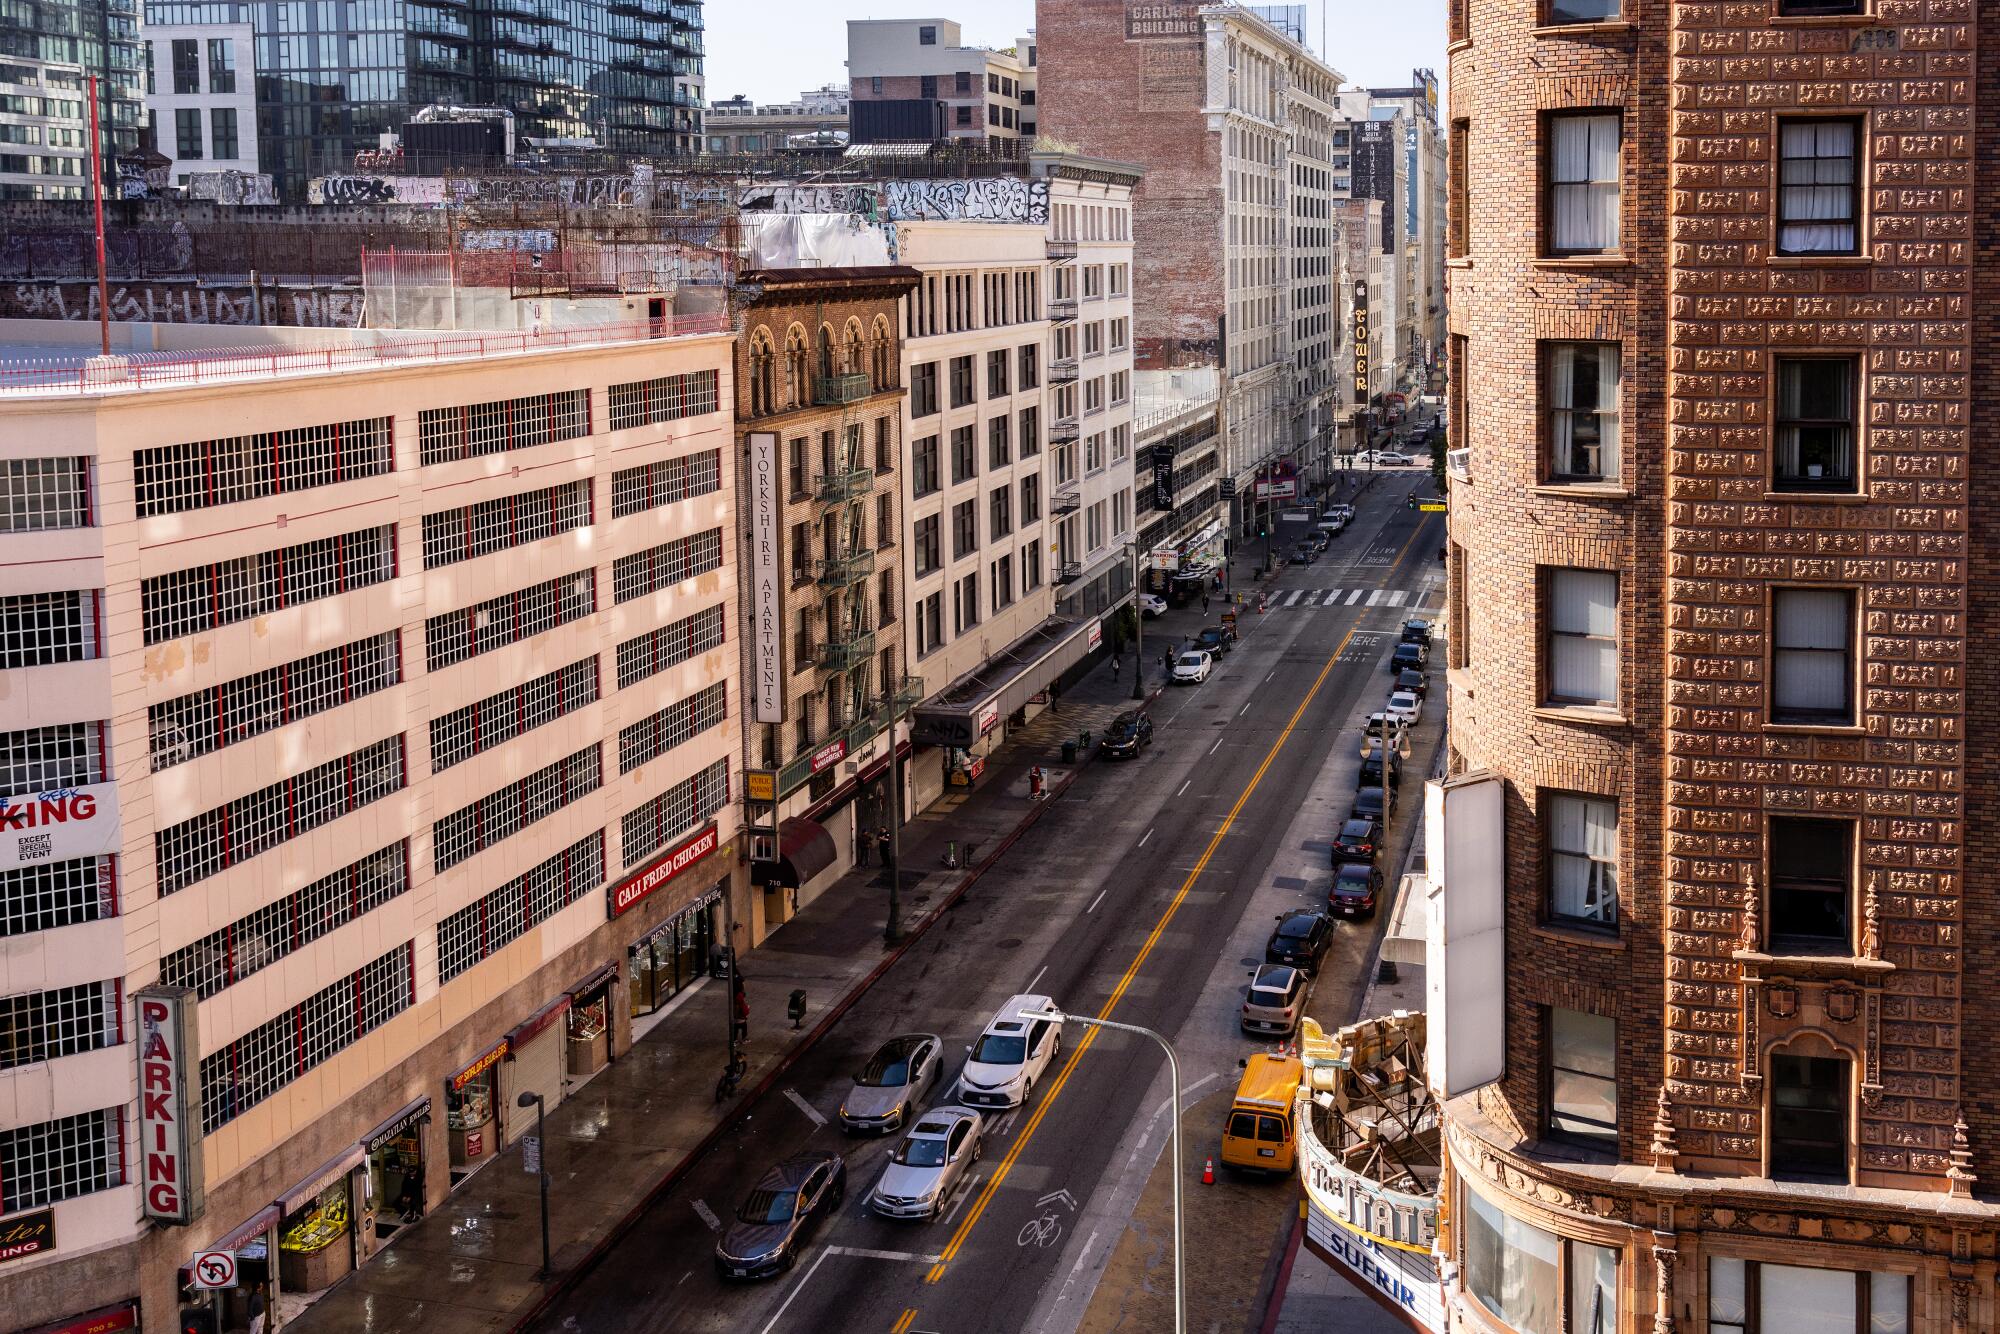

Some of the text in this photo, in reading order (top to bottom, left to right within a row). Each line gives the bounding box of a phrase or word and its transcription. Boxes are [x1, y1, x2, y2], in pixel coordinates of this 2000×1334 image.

[1132, 21, 1198, 34] BUILDING
[1364, 122, 1380, 131] 818
[1355, 309, 1368, 391] TOWER
[757, 446, 771, 567] YORKSHIRE
[1348, 635, 1380, 646] HERE
[38, 788, 79, 801] SEEK
[18, 833, 51, 845] EXCEPT
[20, 841, 50, 852] SPECIAL
[20, 849, 52, 860] EVENT
[618, 832, 715, 907] CALI FRIED CHICKEN
[768, 879, 781, 887] 710
[651, 919, 675, 945] BENNY
[684, 894, 713, 920] JEWELRY
[482, 1042, 507, 1069] JEWELERS
[143, 1001, 178, 1213] PARKING
[379, 1118, 408, 1144] MAZATLAN
[408, 1103, 431, 1125] JEWELERS
[1311, 1160, 1344, 1198] The
[233, 1220, 266, 1251] JEWELRY
[1330, 1232, 1419, 1314] SUFRIR
[87, 1324, 105, 1334] 700
